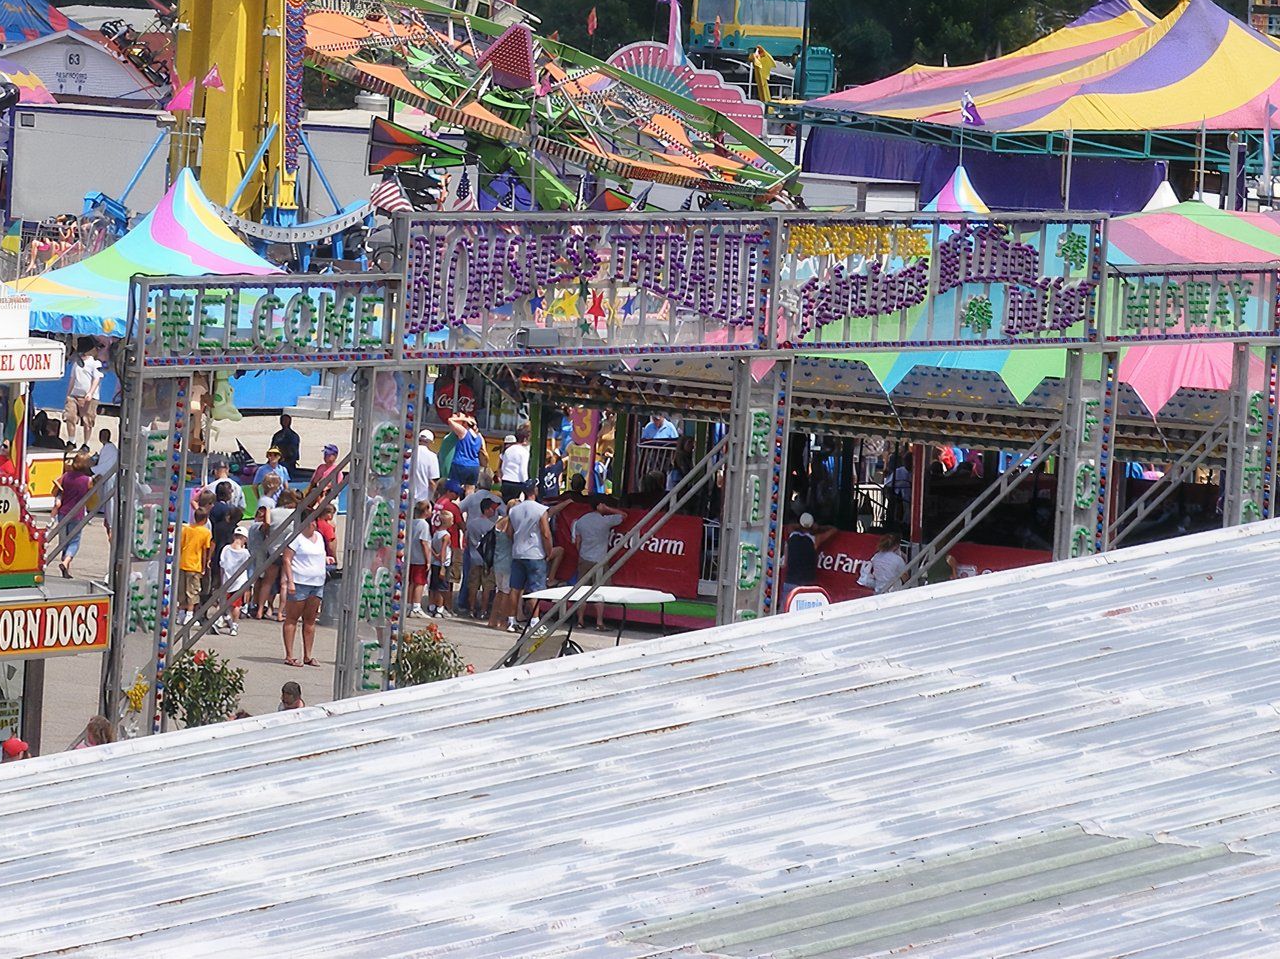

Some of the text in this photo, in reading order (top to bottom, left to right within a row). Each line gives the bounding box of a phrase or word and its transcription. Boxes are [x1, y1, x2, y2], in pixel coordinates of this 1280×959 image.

[68, 53, 81, 65] 63
[156, 292, 384, 354] WELCOME
[19, 353, 52, 370] CORN
[44, 603, 98, 647] DOGS
